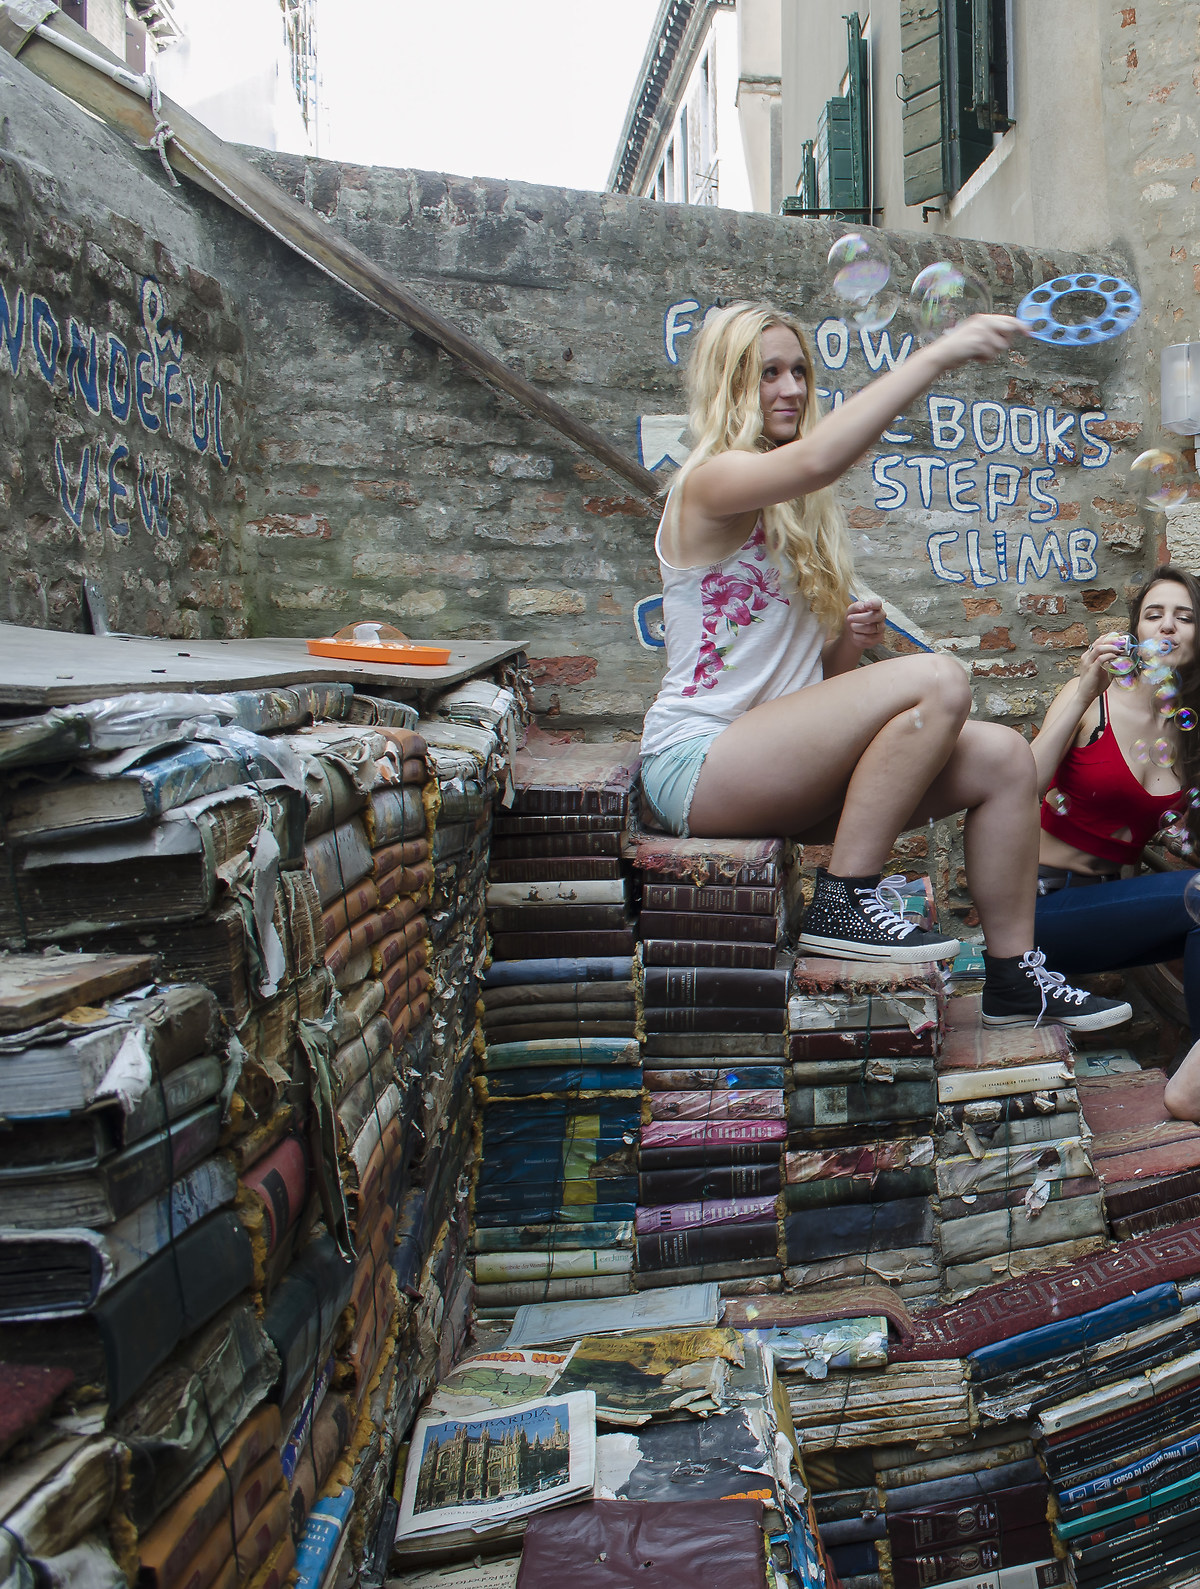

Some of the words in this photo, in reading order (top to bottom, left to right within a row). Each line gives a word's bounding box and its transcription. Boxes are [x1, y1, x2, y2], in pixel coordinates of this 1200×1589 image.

[664, 298, 913, 372] FOW
[927, 394, 1111, 468] BOOKS
[55, 439, 171, 540] VIEW
[873, 454, 1058, 523] STEPS
[927, 527, 1098, 588] CLIMB
[443, 1408, 552, 1432] LOMBARDIA
[1062, 1471, 1093, 1489] VIAGGIO
[1113, 1471, 1134, 1486] CORSO
[1142, 1449, 1182, 1473] ASTRONOMIA
